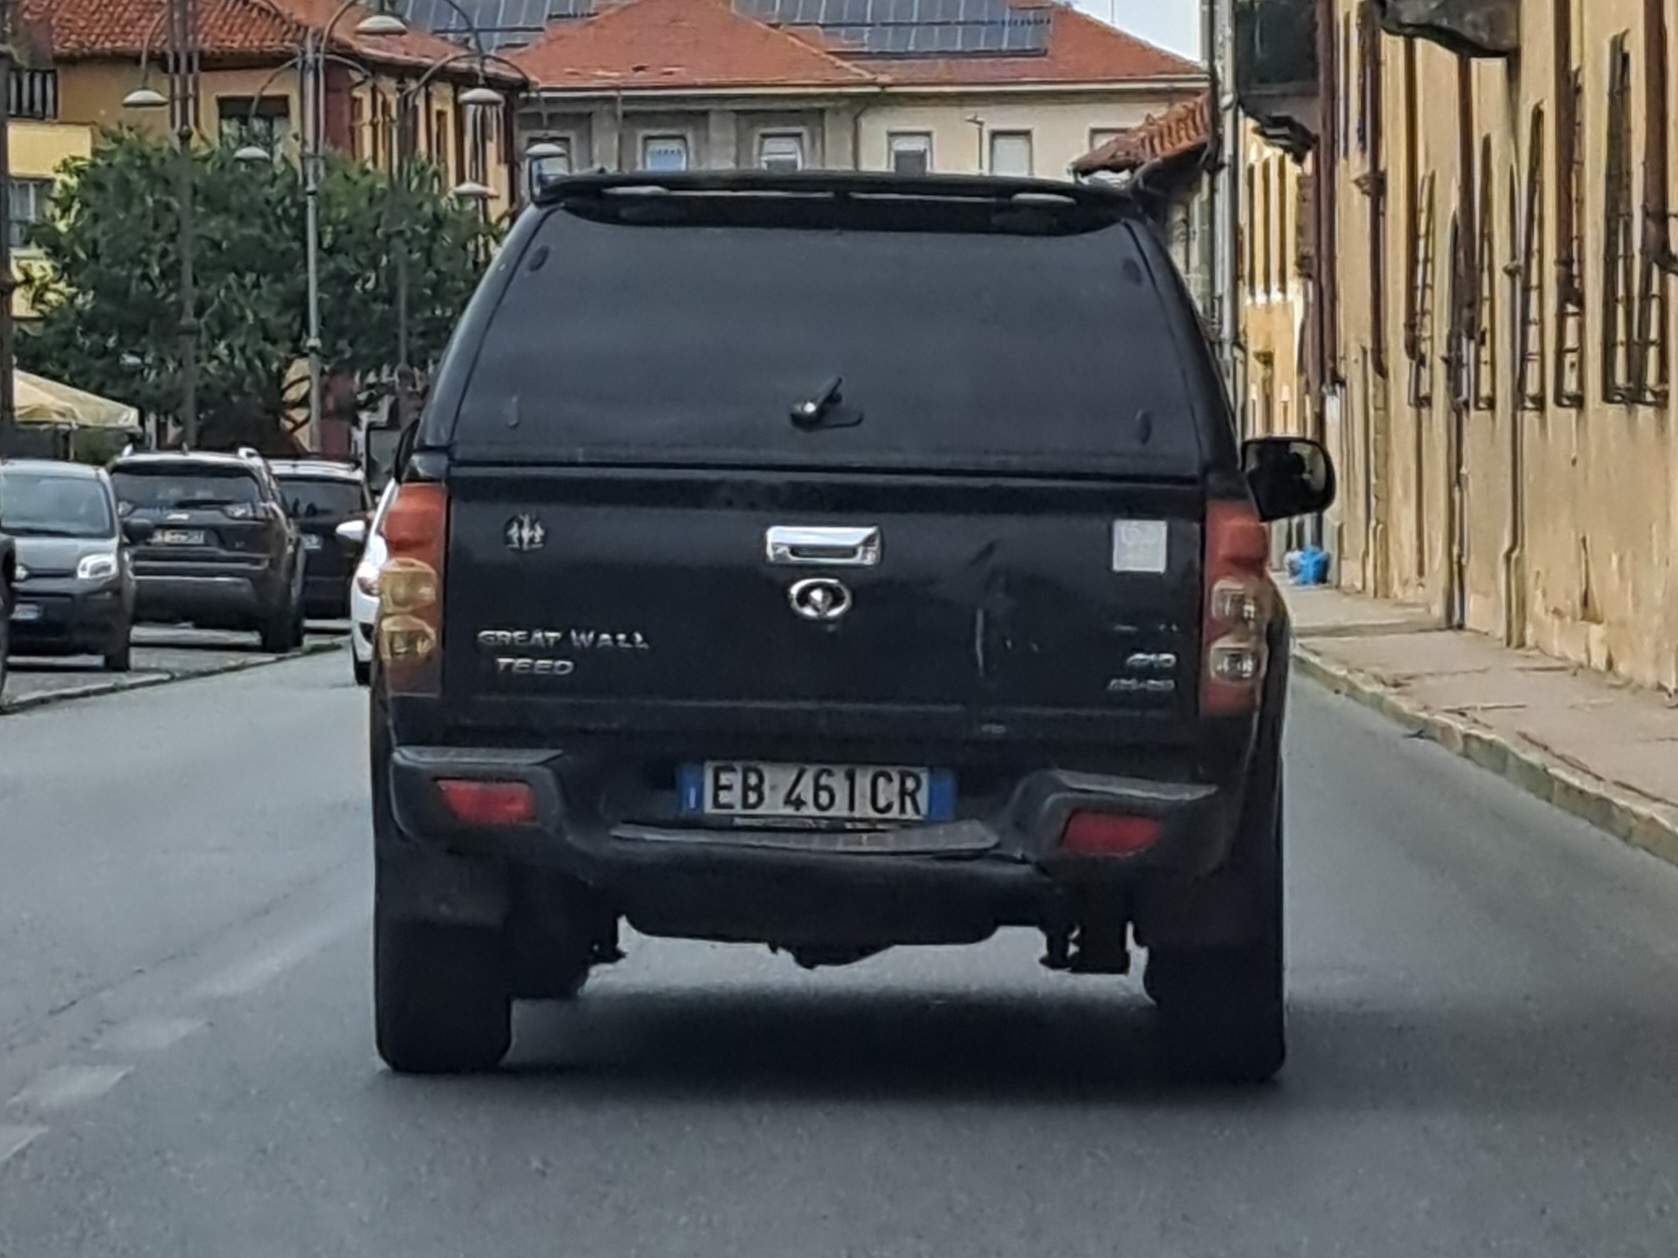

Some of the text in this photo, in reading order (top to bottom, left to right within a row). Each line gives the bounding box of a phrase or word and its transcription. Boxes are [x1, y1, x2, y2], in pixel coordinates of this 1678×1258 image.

[477, 629, 650, 649] GREAT WALL
[711, 764, 766, 811] EB
[782, 766, 923, 816] 461CR
